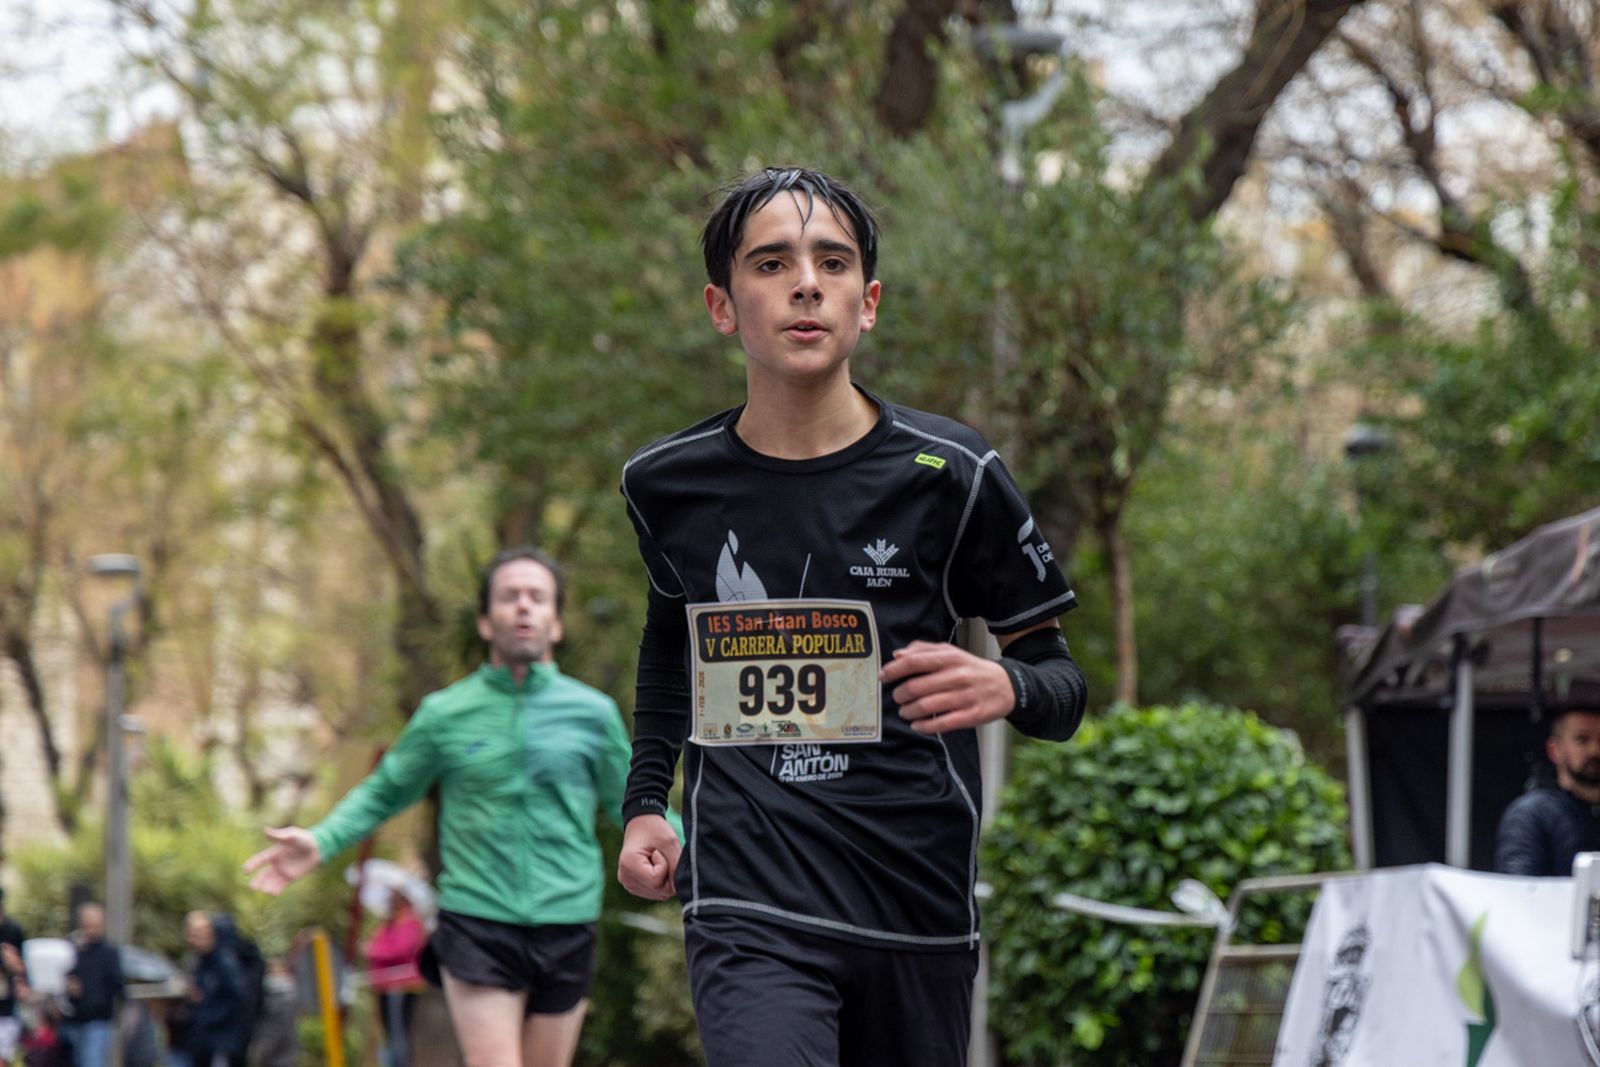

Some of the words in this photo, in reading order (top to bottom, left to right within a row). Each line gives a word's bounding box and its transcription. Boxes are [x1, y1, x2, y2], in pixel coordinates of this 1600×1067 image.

[866, 575, 893, 588] JAÉN
[876, 566, 911, 578] RURAL
[708, 616, 730, 633] IES
[735, 613, 763, 632] San
[767, 612, 806, 631] Juan
[812, 611, 857, 629] Bosco
[706, 638, 716, 657] V
[720, 634, 787, 657] CARRERA
[791, 633, 866, 654] POPULAR
[739, 664, 826, 716] 939
[781, 744, 821, 760] SAN
[779, 751, 849, 776] ANTÓN
